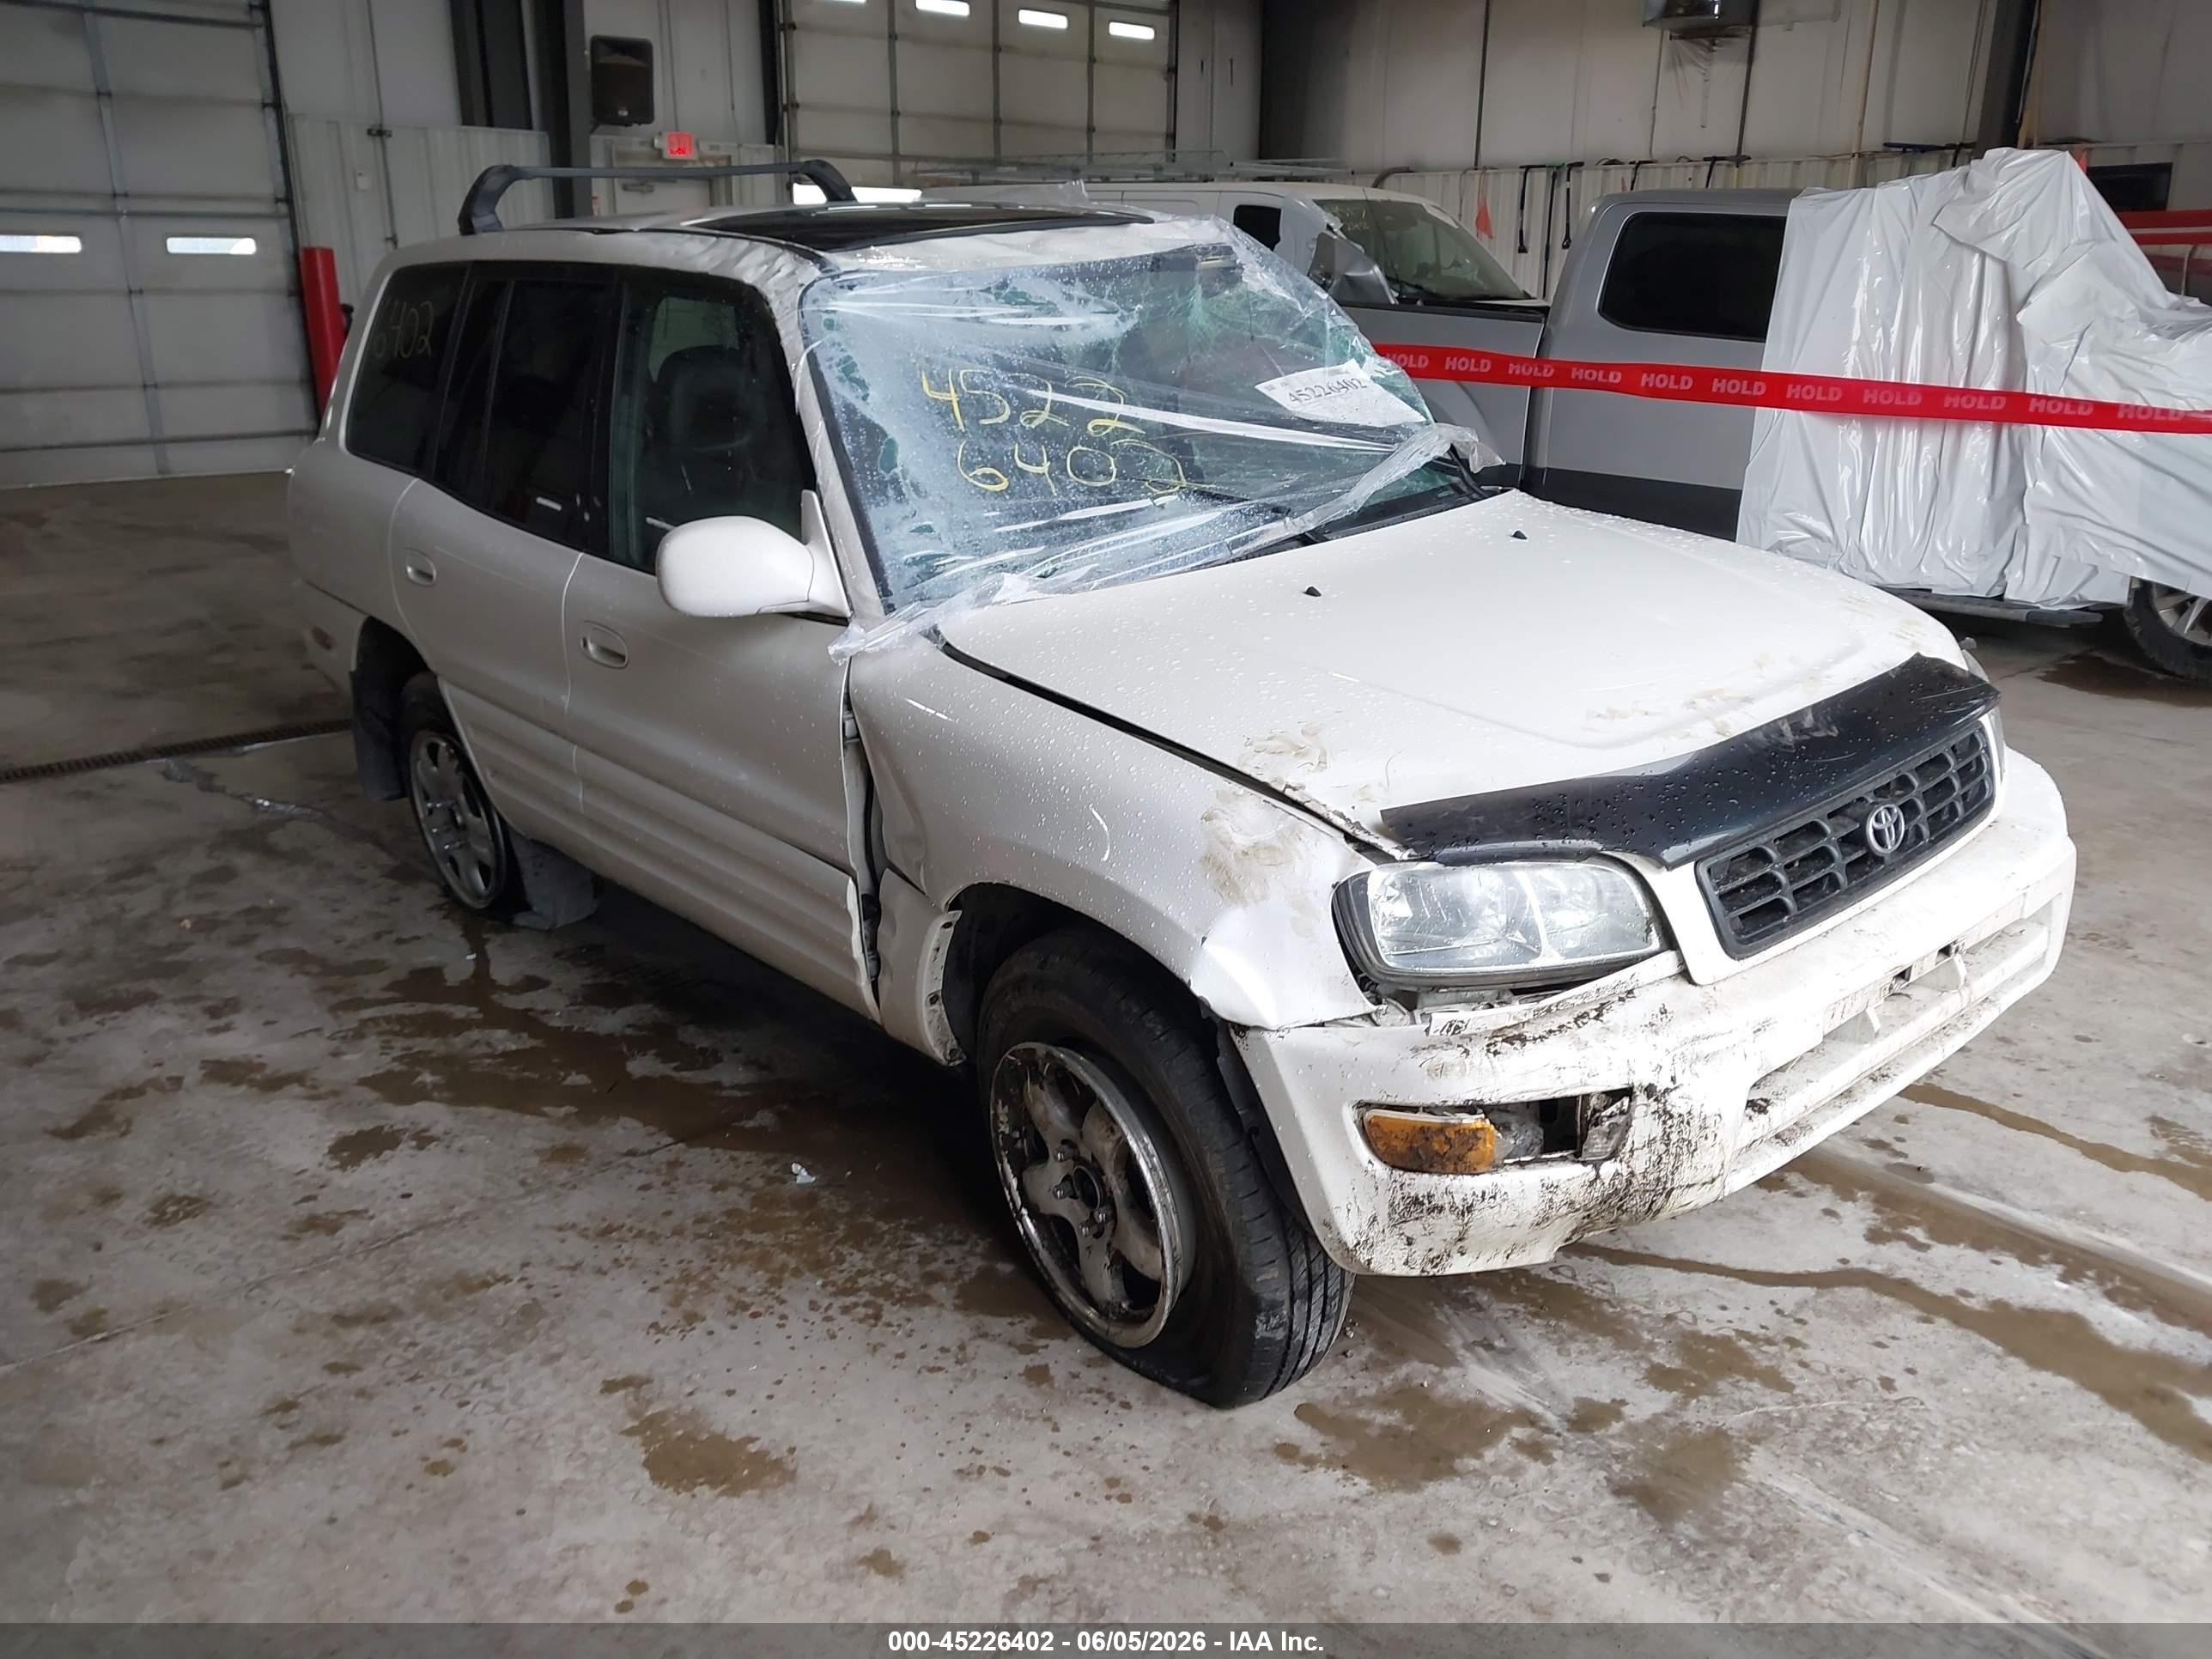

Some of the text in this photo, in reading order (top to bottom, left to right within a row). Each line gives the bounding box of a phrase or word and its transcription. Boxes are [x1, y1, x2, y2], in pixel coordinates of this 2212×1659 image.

[921, 368, 1147, 437] 4522
[1444, 356, 1492, 373] HOLD
[1571, 367, 1622, 383] HOLD
[1641, 373, 1694, 391] HOLD
[1711, 378, 1767, 397] HOLD
[1786, 384, 1842, 402] HOLD
[1863, 389, 1923, 406] HOLD
[1943, 393, 2007, 410] HOLD
[2028, 398, 2094, 416] HOLD
